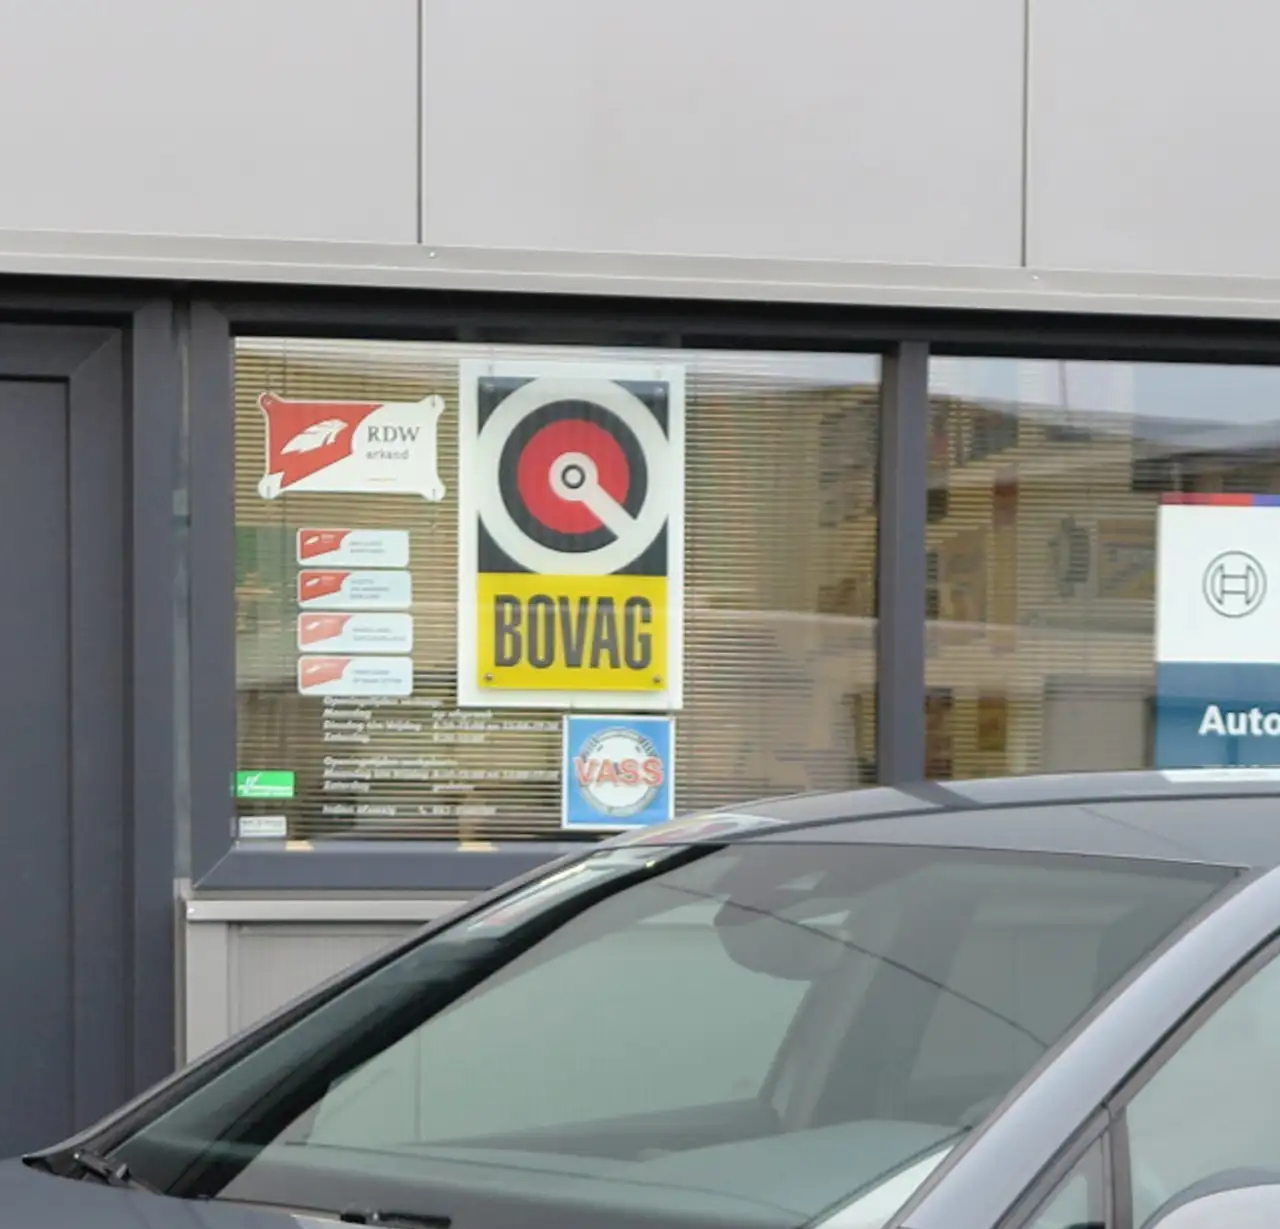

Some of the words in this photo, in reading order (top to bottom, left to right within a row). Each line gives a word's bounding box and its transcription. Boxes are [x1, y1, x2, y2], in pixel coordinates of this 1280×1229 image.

[367, 426, 421, 443] RDW
[494, 594, 653, 671] BOVAG
[573, 756, 664, 788] VASS
